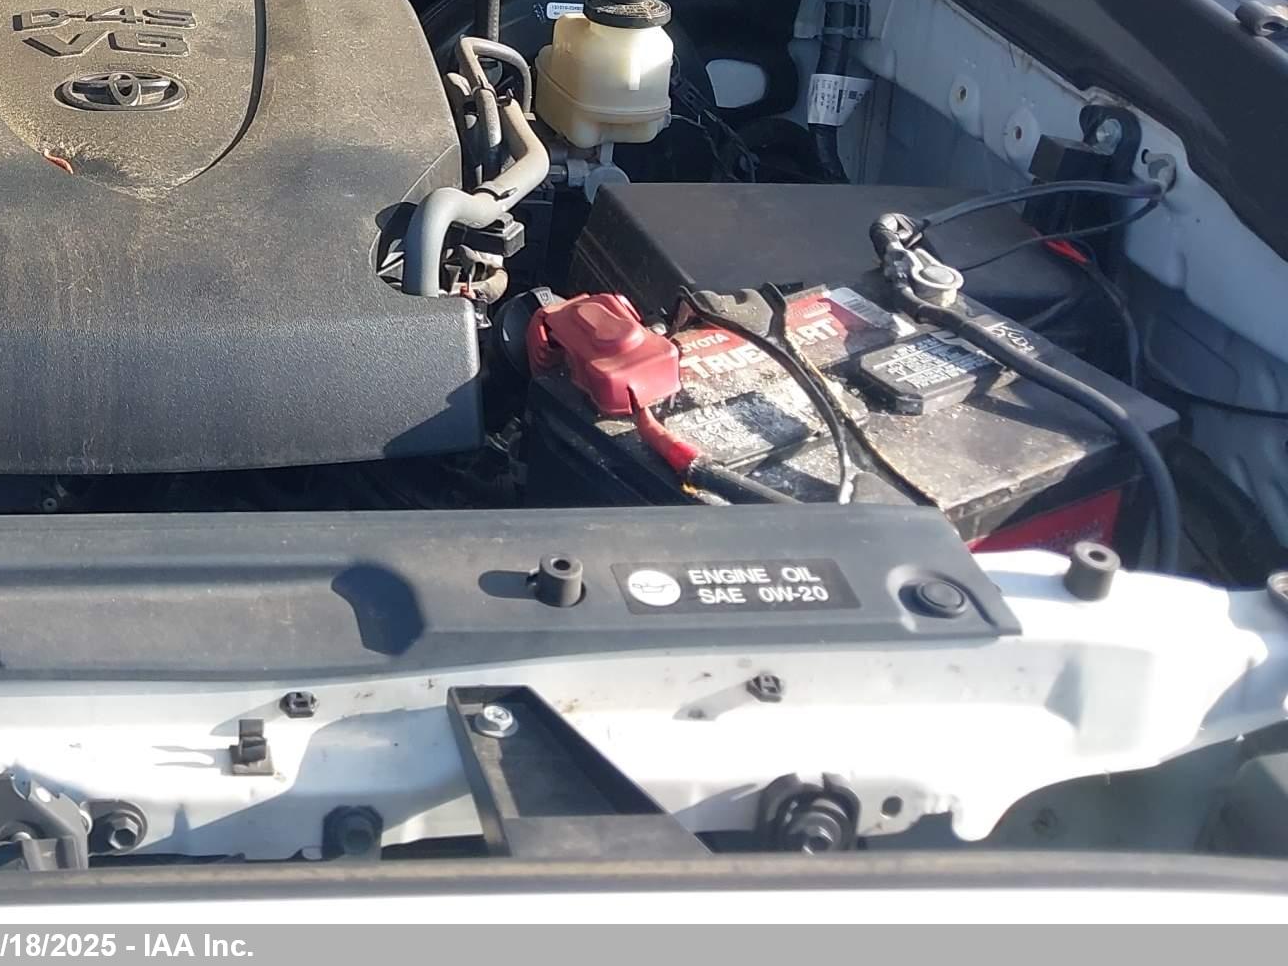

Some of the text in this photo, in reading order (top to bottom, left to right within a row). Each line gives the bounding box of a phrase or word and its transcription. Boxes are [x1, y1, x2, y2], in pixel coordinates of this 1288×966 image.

[12, 6, 198, 32] D-4S
[22, 31, 191, 58] V6
[687, 566, 821, 586] ENGINE OIL
[698, 585, 829, 605] SAE 0W-20
